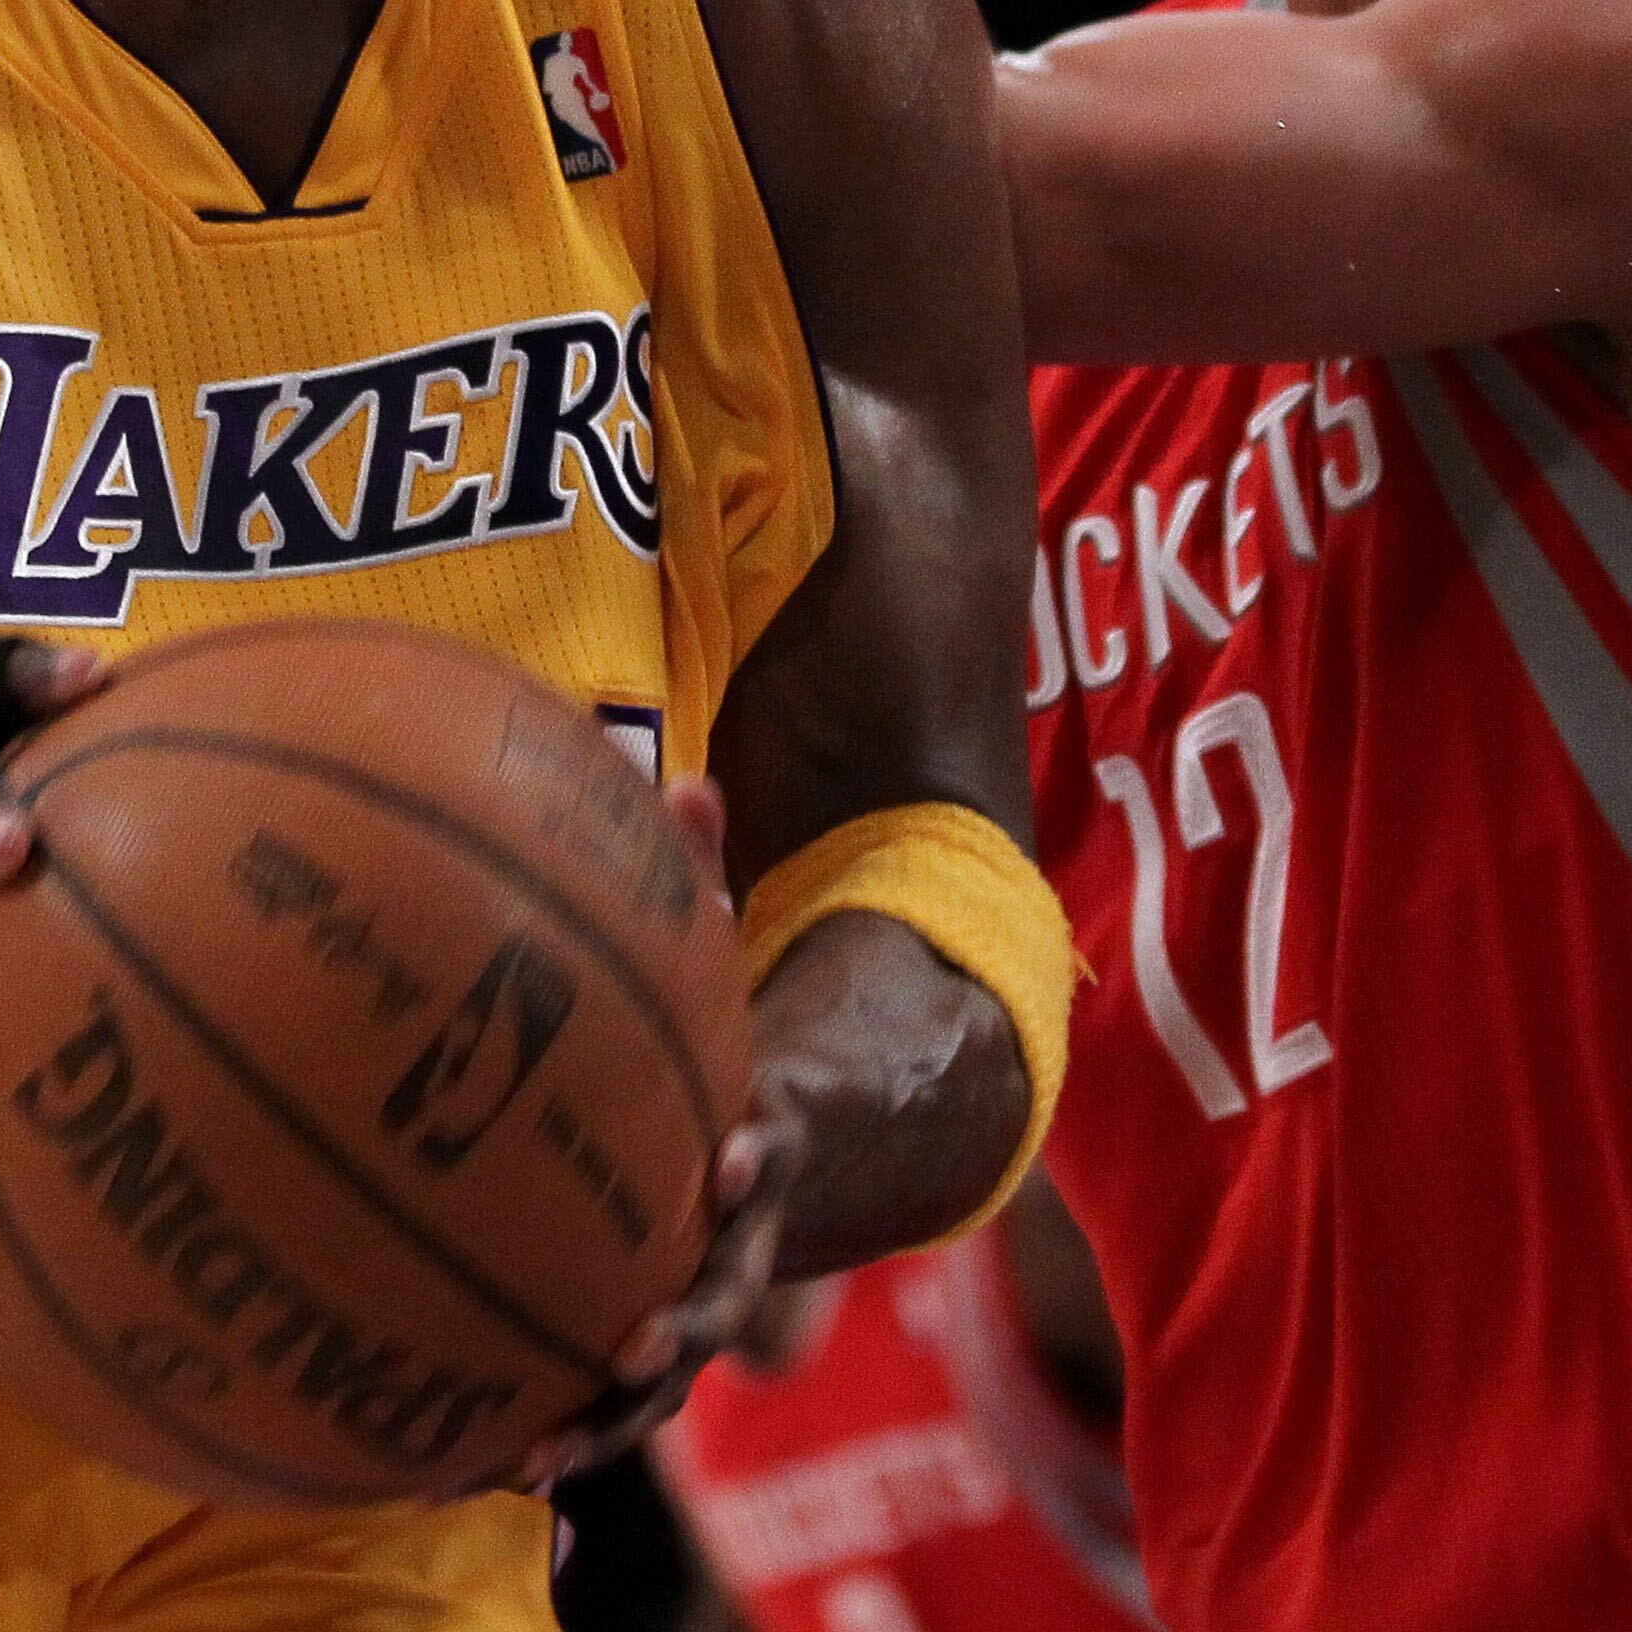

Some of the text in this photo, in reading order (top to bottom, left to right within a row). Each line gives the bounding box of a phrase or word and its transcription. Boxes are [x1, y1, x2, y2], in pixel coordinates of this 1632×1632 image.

[562, 147, 608, 178] NBA
[1025, 356, 1382, 711] OCKETS
[1094, 690, 1334, 1121] 12
[15, 988, 523, 1463] SPALDING
